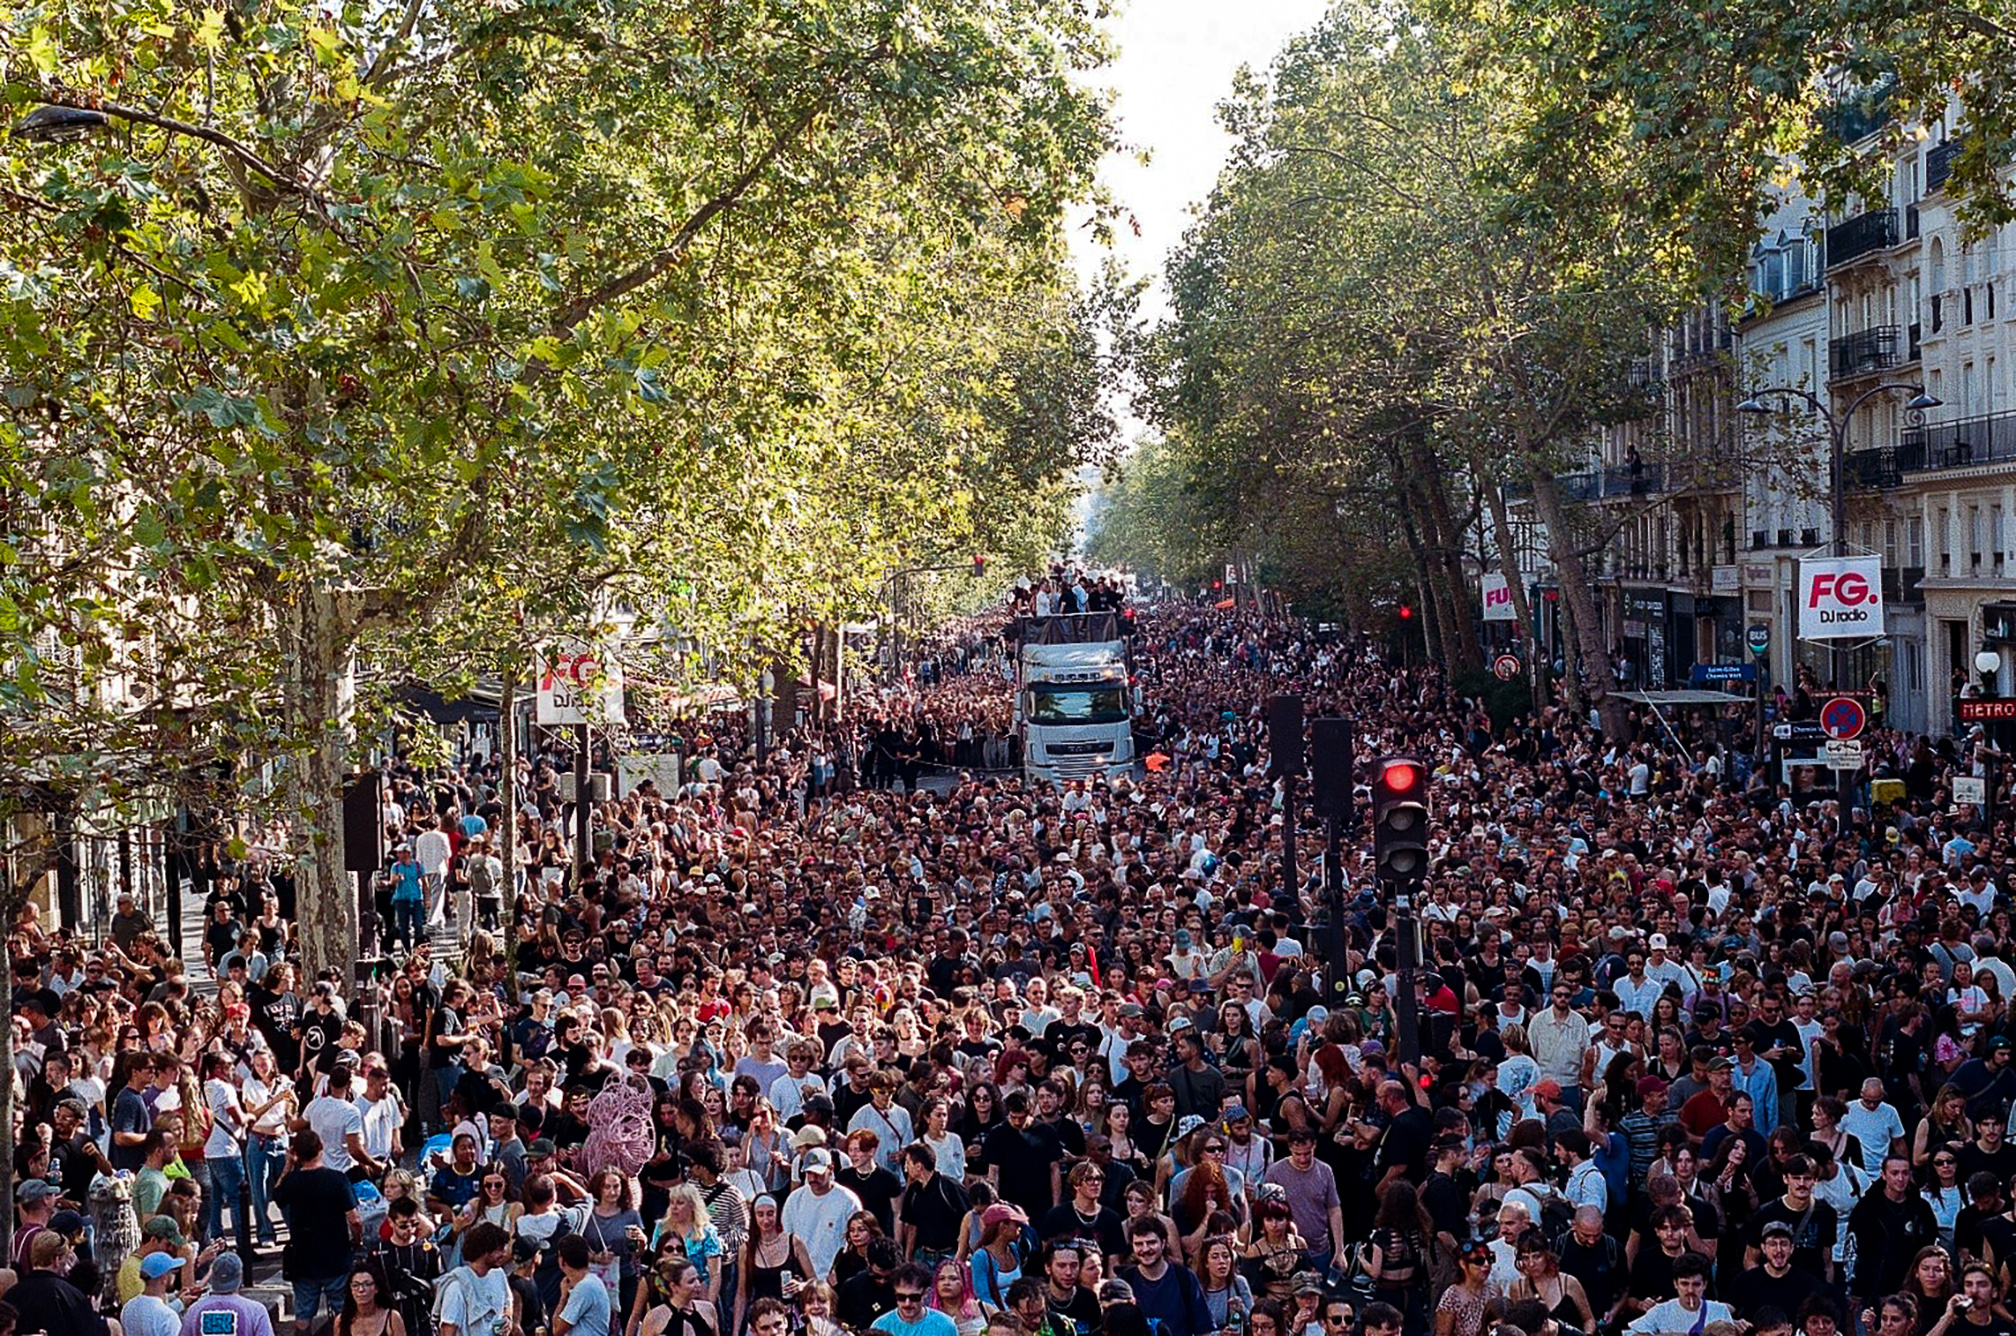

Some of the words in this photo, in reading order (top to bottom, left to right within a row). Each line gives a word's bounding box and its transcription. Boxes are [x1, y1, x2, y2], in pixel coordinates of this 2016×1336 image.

[1808, 572, 1878, 608] FG.
[1820, 609, 1835, 623] DJ
[1836, 608, 1868, 622] radio
[1749, 630, 1768, 640] BUS
[1963, 703, 2015, 717] METRO
